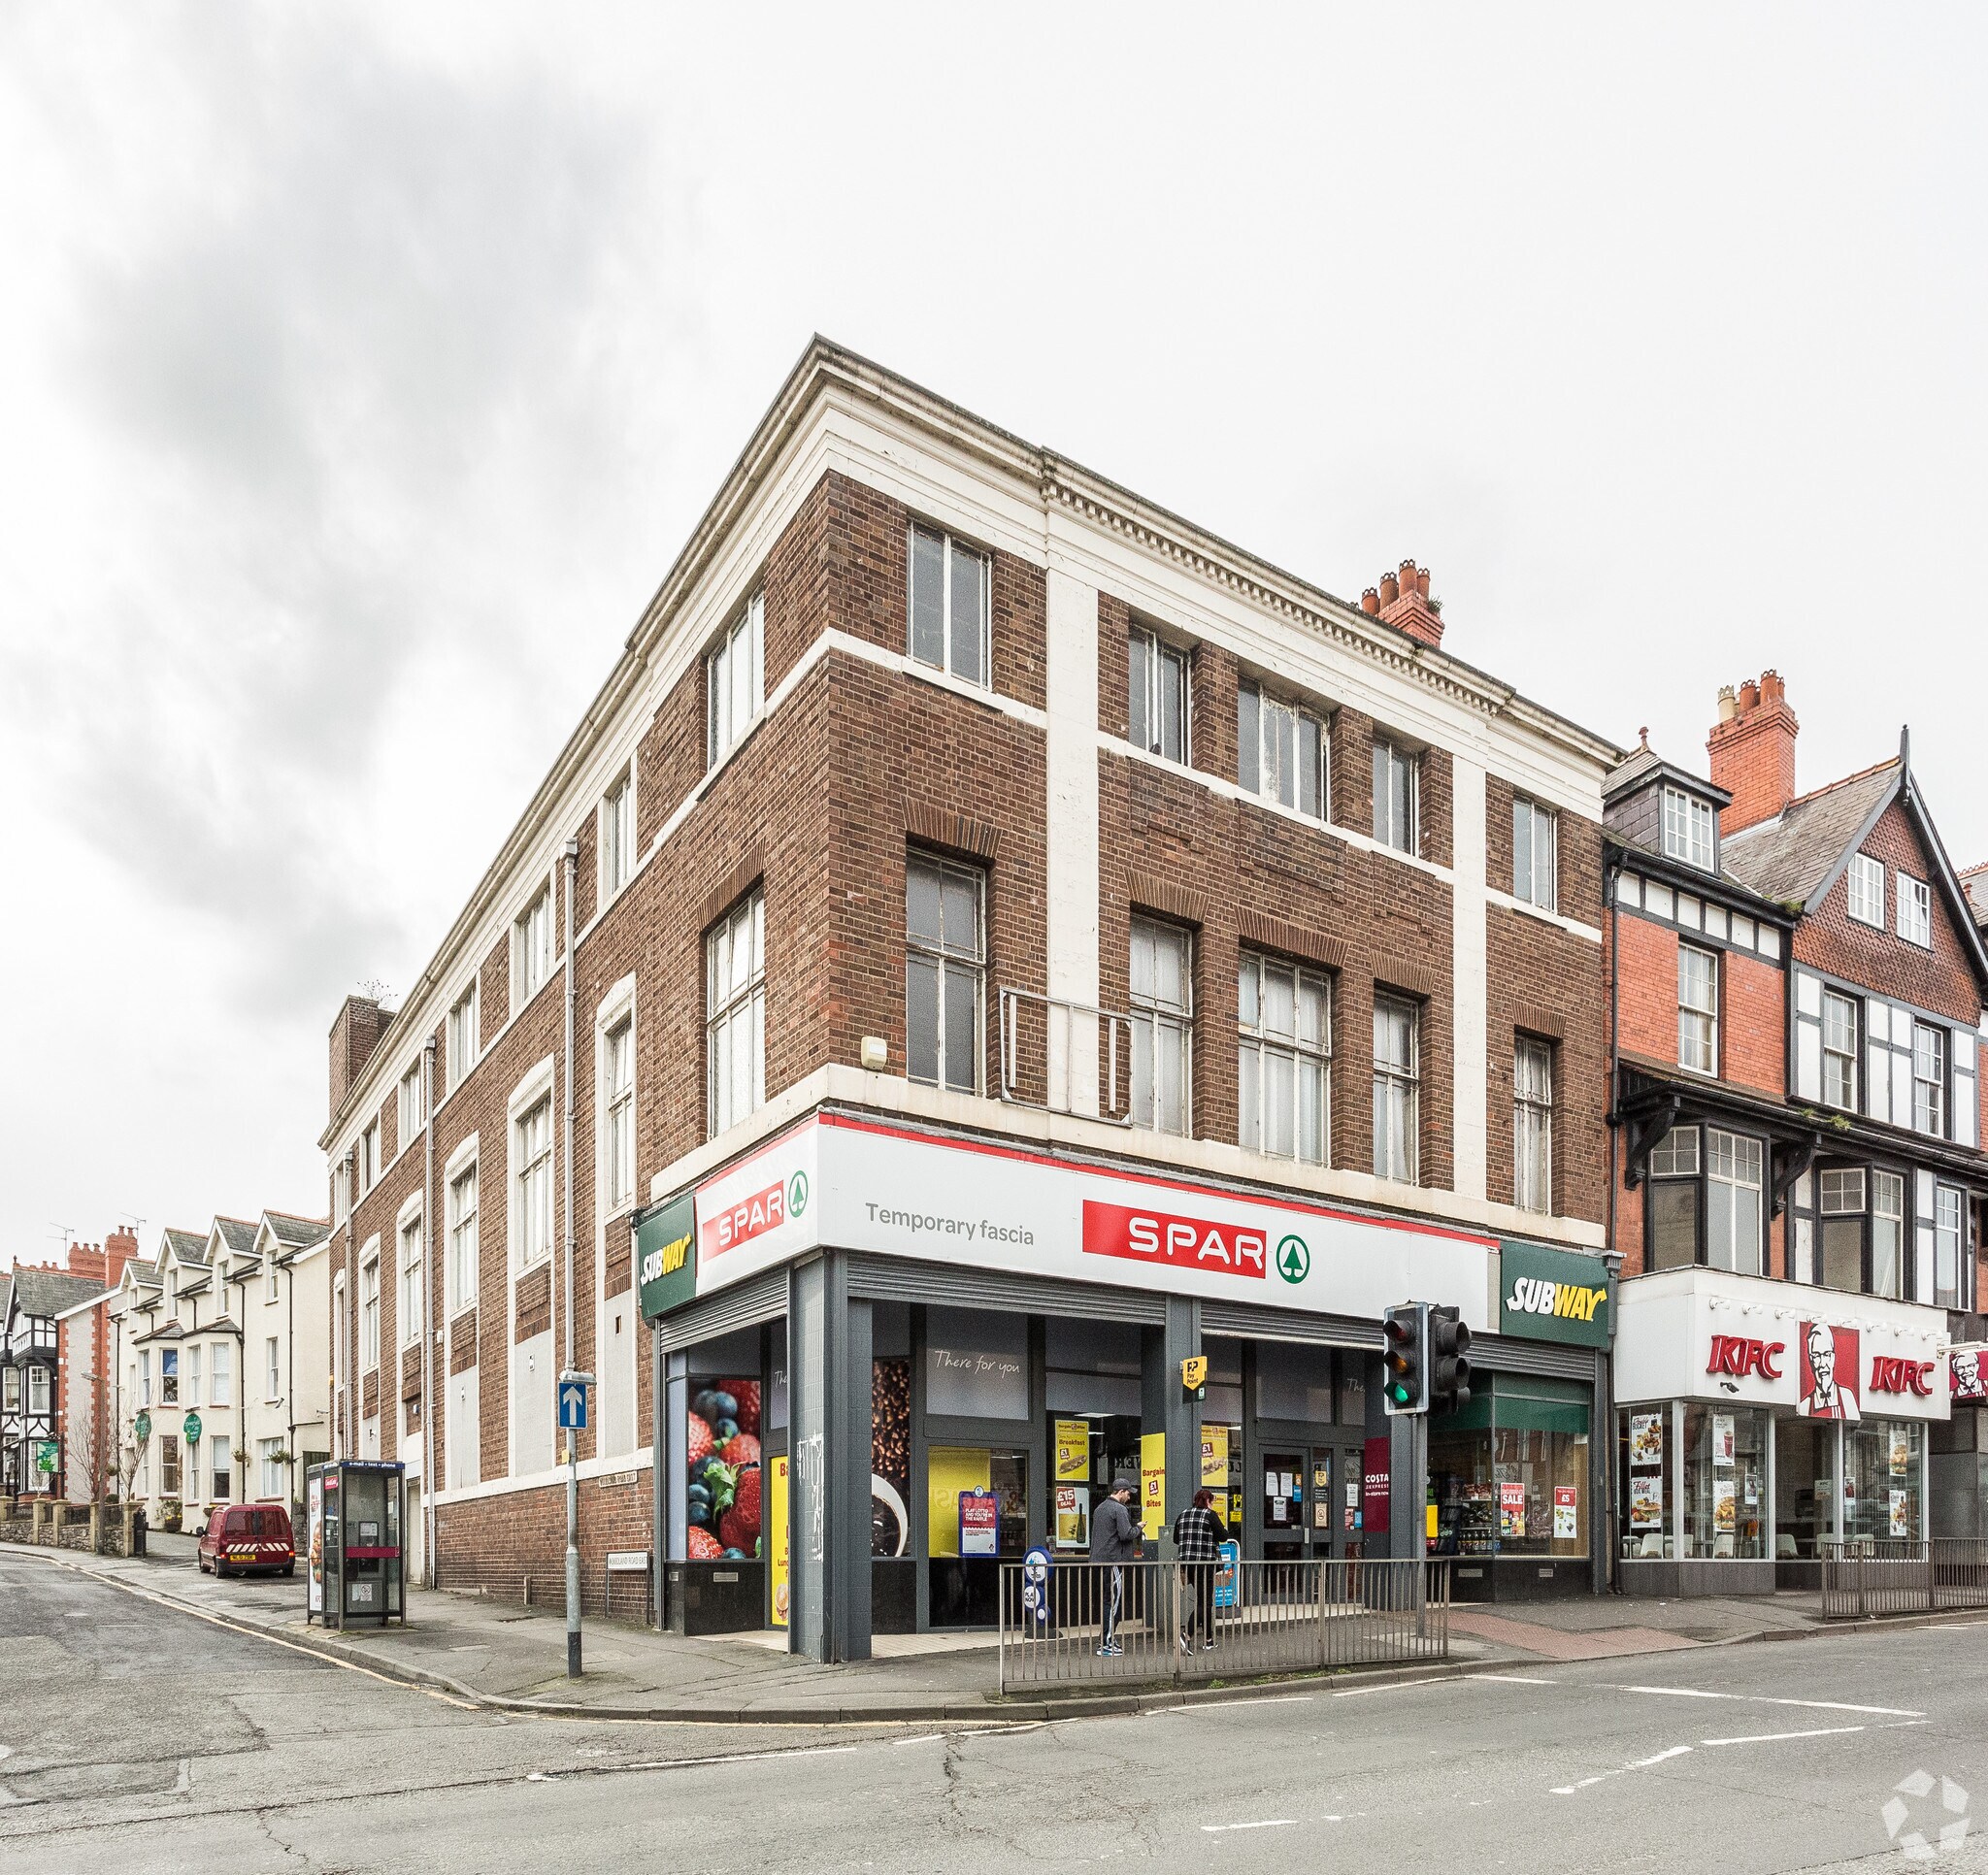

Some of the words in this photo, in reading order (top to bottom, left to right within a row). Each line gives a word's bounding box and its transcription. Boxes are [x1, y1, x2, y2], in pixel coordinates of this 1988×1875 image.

[718, 1189, 783, 1247] SPAR
[865, 1202, 977, 1241] Temporary
[979, 1219, 1034, 1246] fascia
[640, 1232, 692, 1286] SUBWAY
[1129, 1216, 1264, 1269] SPAR
[1507, 1277, 1607, 1322] SUBWAY
[935, 1349, 972, 1368] There
[975, 1355, 996, 1374] for
[999, 1361, 1020, 1379] you
[1706, 1334, 1785, 1380] KFC
[1869, 1356, 1936, 1397] KFC
[1202, 1443, 1210, 1453] £1
[1143, 1466, 1165, 1478] Bargain
[1365, 1473, 1389, 1484] COSTA
[1057, 1490, 1075, 1501] £15
[1503, 1495, 1523, 1504] SALE
[1561, 1494, 1570, 1502] £5
